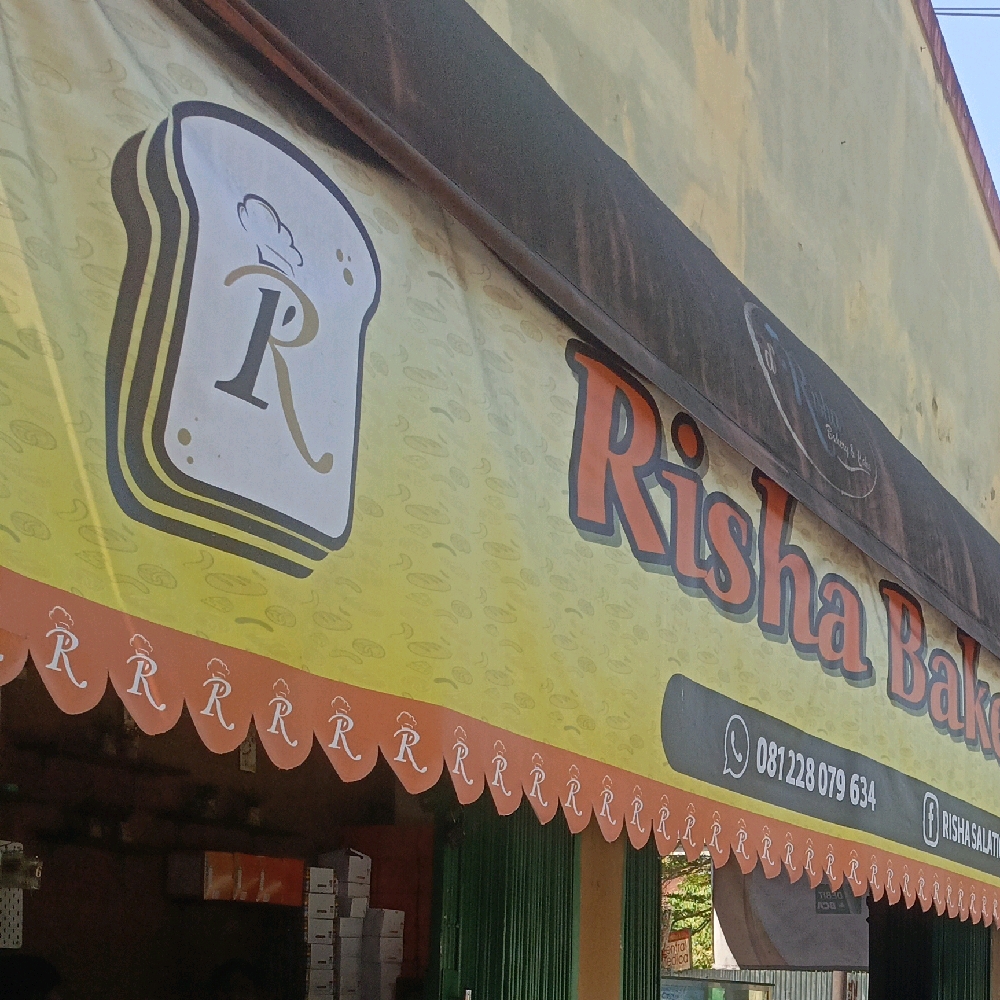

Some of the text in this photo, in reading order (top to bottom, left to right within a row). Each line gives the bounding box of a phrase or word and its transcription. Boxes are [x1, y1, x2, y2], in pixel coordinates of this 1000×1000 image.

[565, 338, 874, 684] Risha
[817, 761, 846, 802] 079
[850, 773, 877, 812] 634
[942, 810, 971, 848] RISHA
